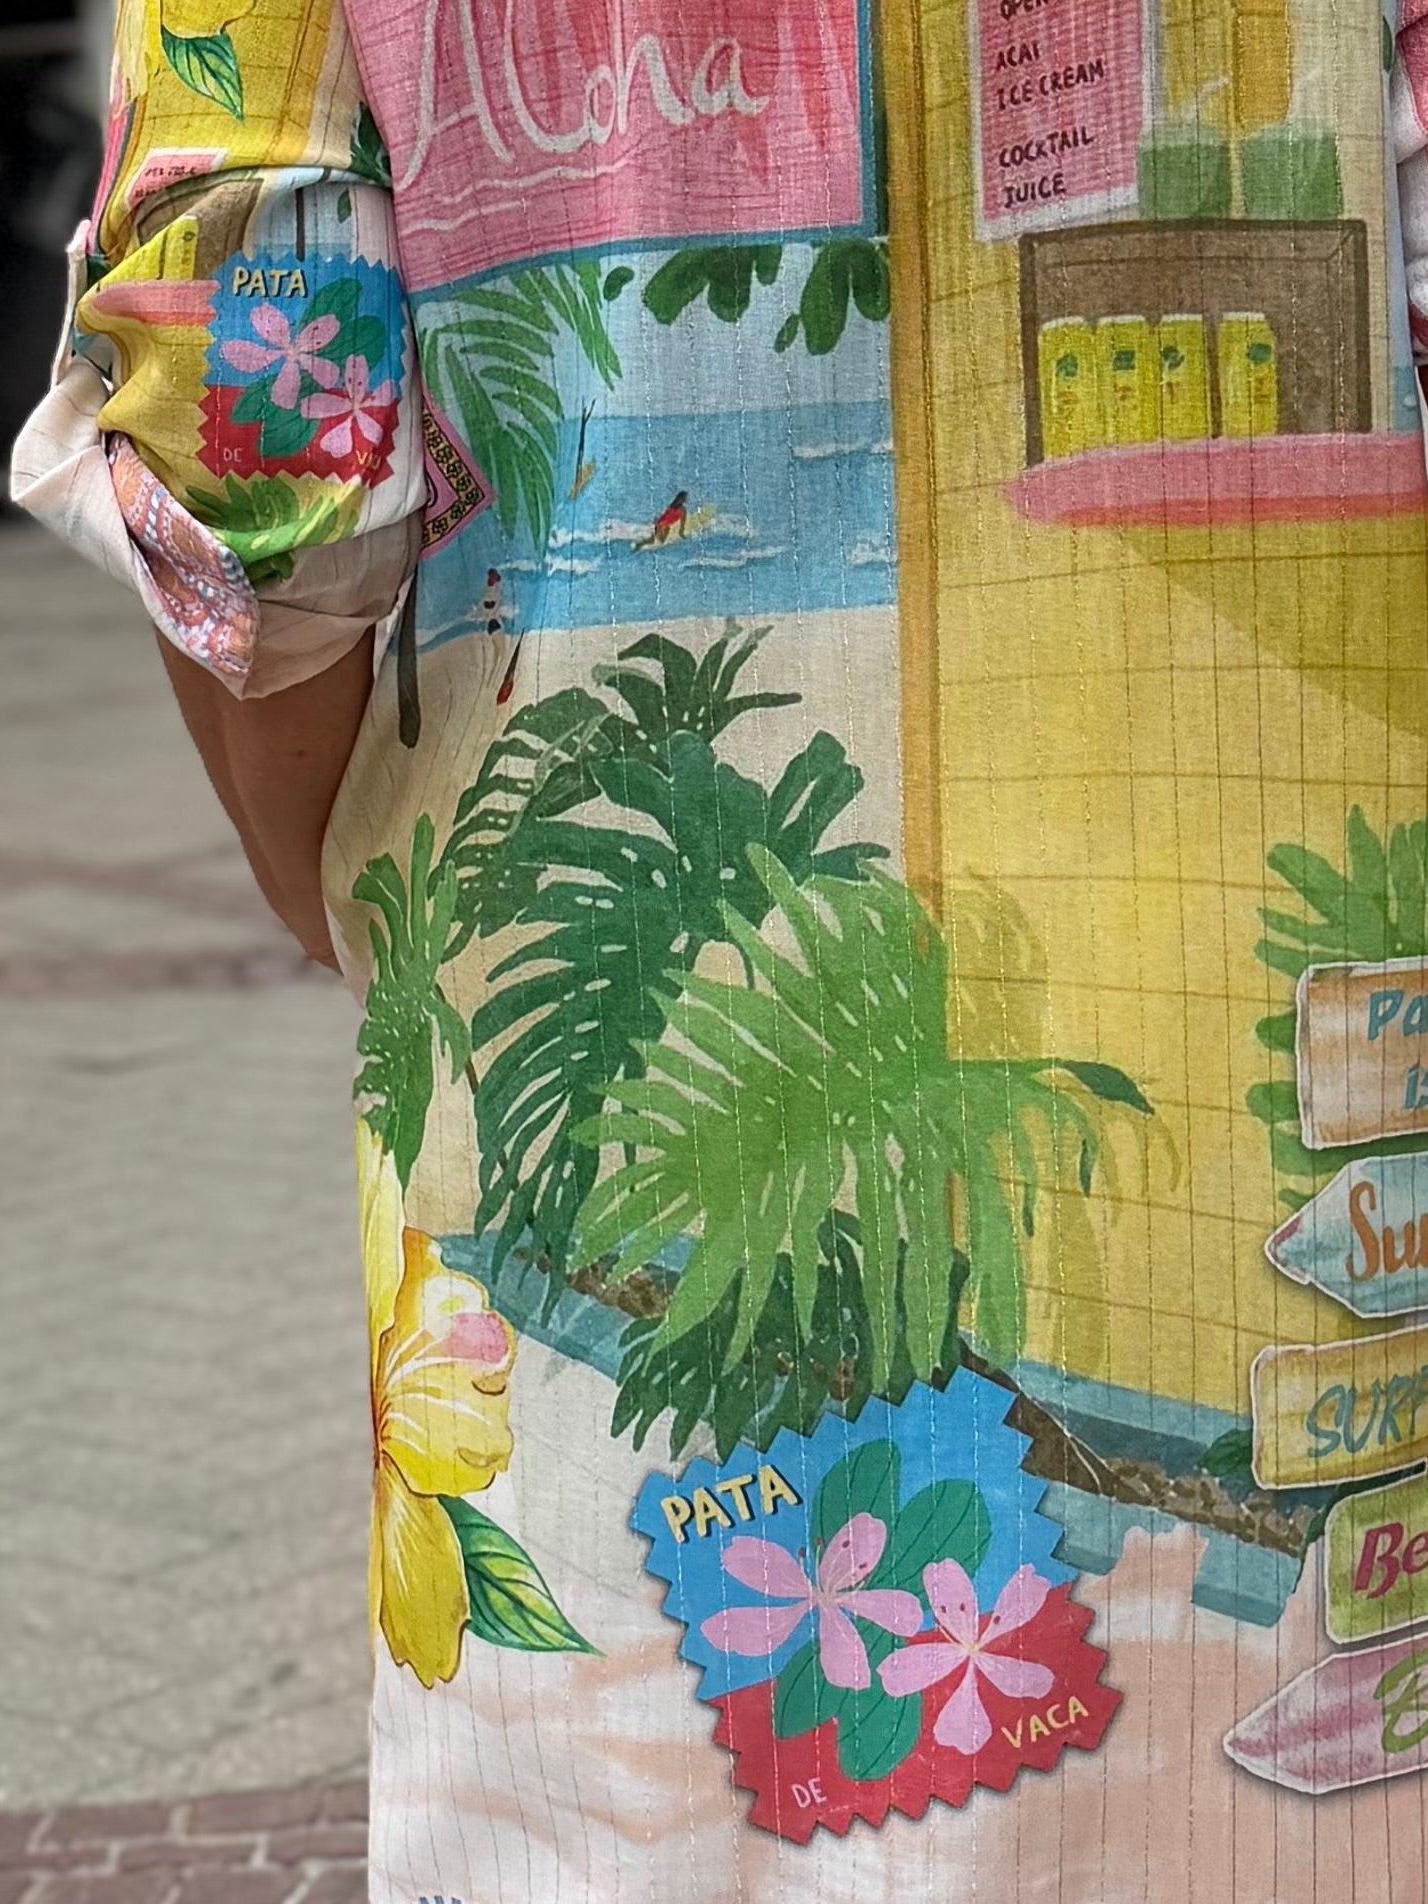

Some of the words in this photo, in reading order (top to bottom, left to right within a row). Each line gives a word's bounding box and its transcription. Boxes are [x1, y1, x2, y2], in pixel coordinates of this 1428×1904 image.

[995, 42, 1041, 72] ACAI
[996, 78, 1033, 111] ICE
[1038, 57, 1106, 97] CREAM
[998, 126, 1095, 169] COCKTAIL
[1003, 171, 1067, 210] JUICE
[232, 265, 308, 298] PATA
[222, 447, 243, 463] DE
[660, 1463, 805, 1544] PATA
[1001, 1695, 1090, 1749] VACA
[790, 1777, 828, 1810] DE
